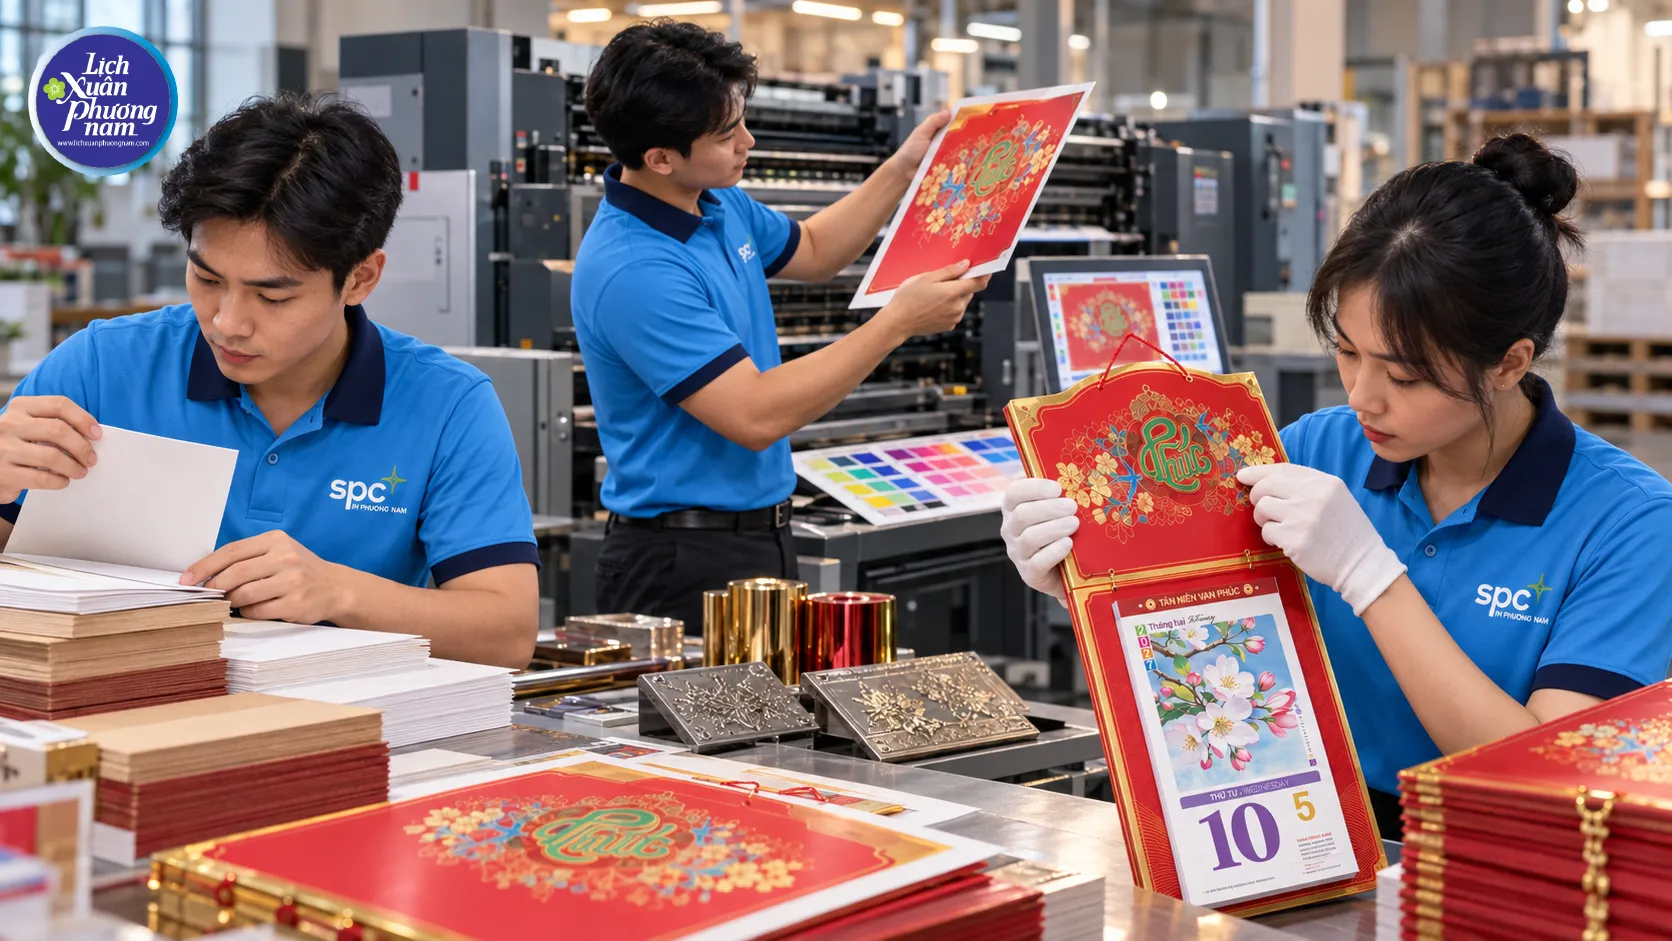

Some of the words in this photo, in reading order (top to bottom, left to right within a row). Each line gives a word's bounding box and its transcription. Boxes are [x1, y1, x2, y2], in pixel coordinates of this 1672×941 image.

[1139, 416, 1212, 493] Phúc
[329, 479, 387, 511] spc
[1216, 585, 1241, 598] PHÚC
[1474, 583, 1532, 618] spc
[1173, 618, 1186, 627] hai
[1292, 790, 1317, 822] 5
[1198, 802, 1281, 872] 10
